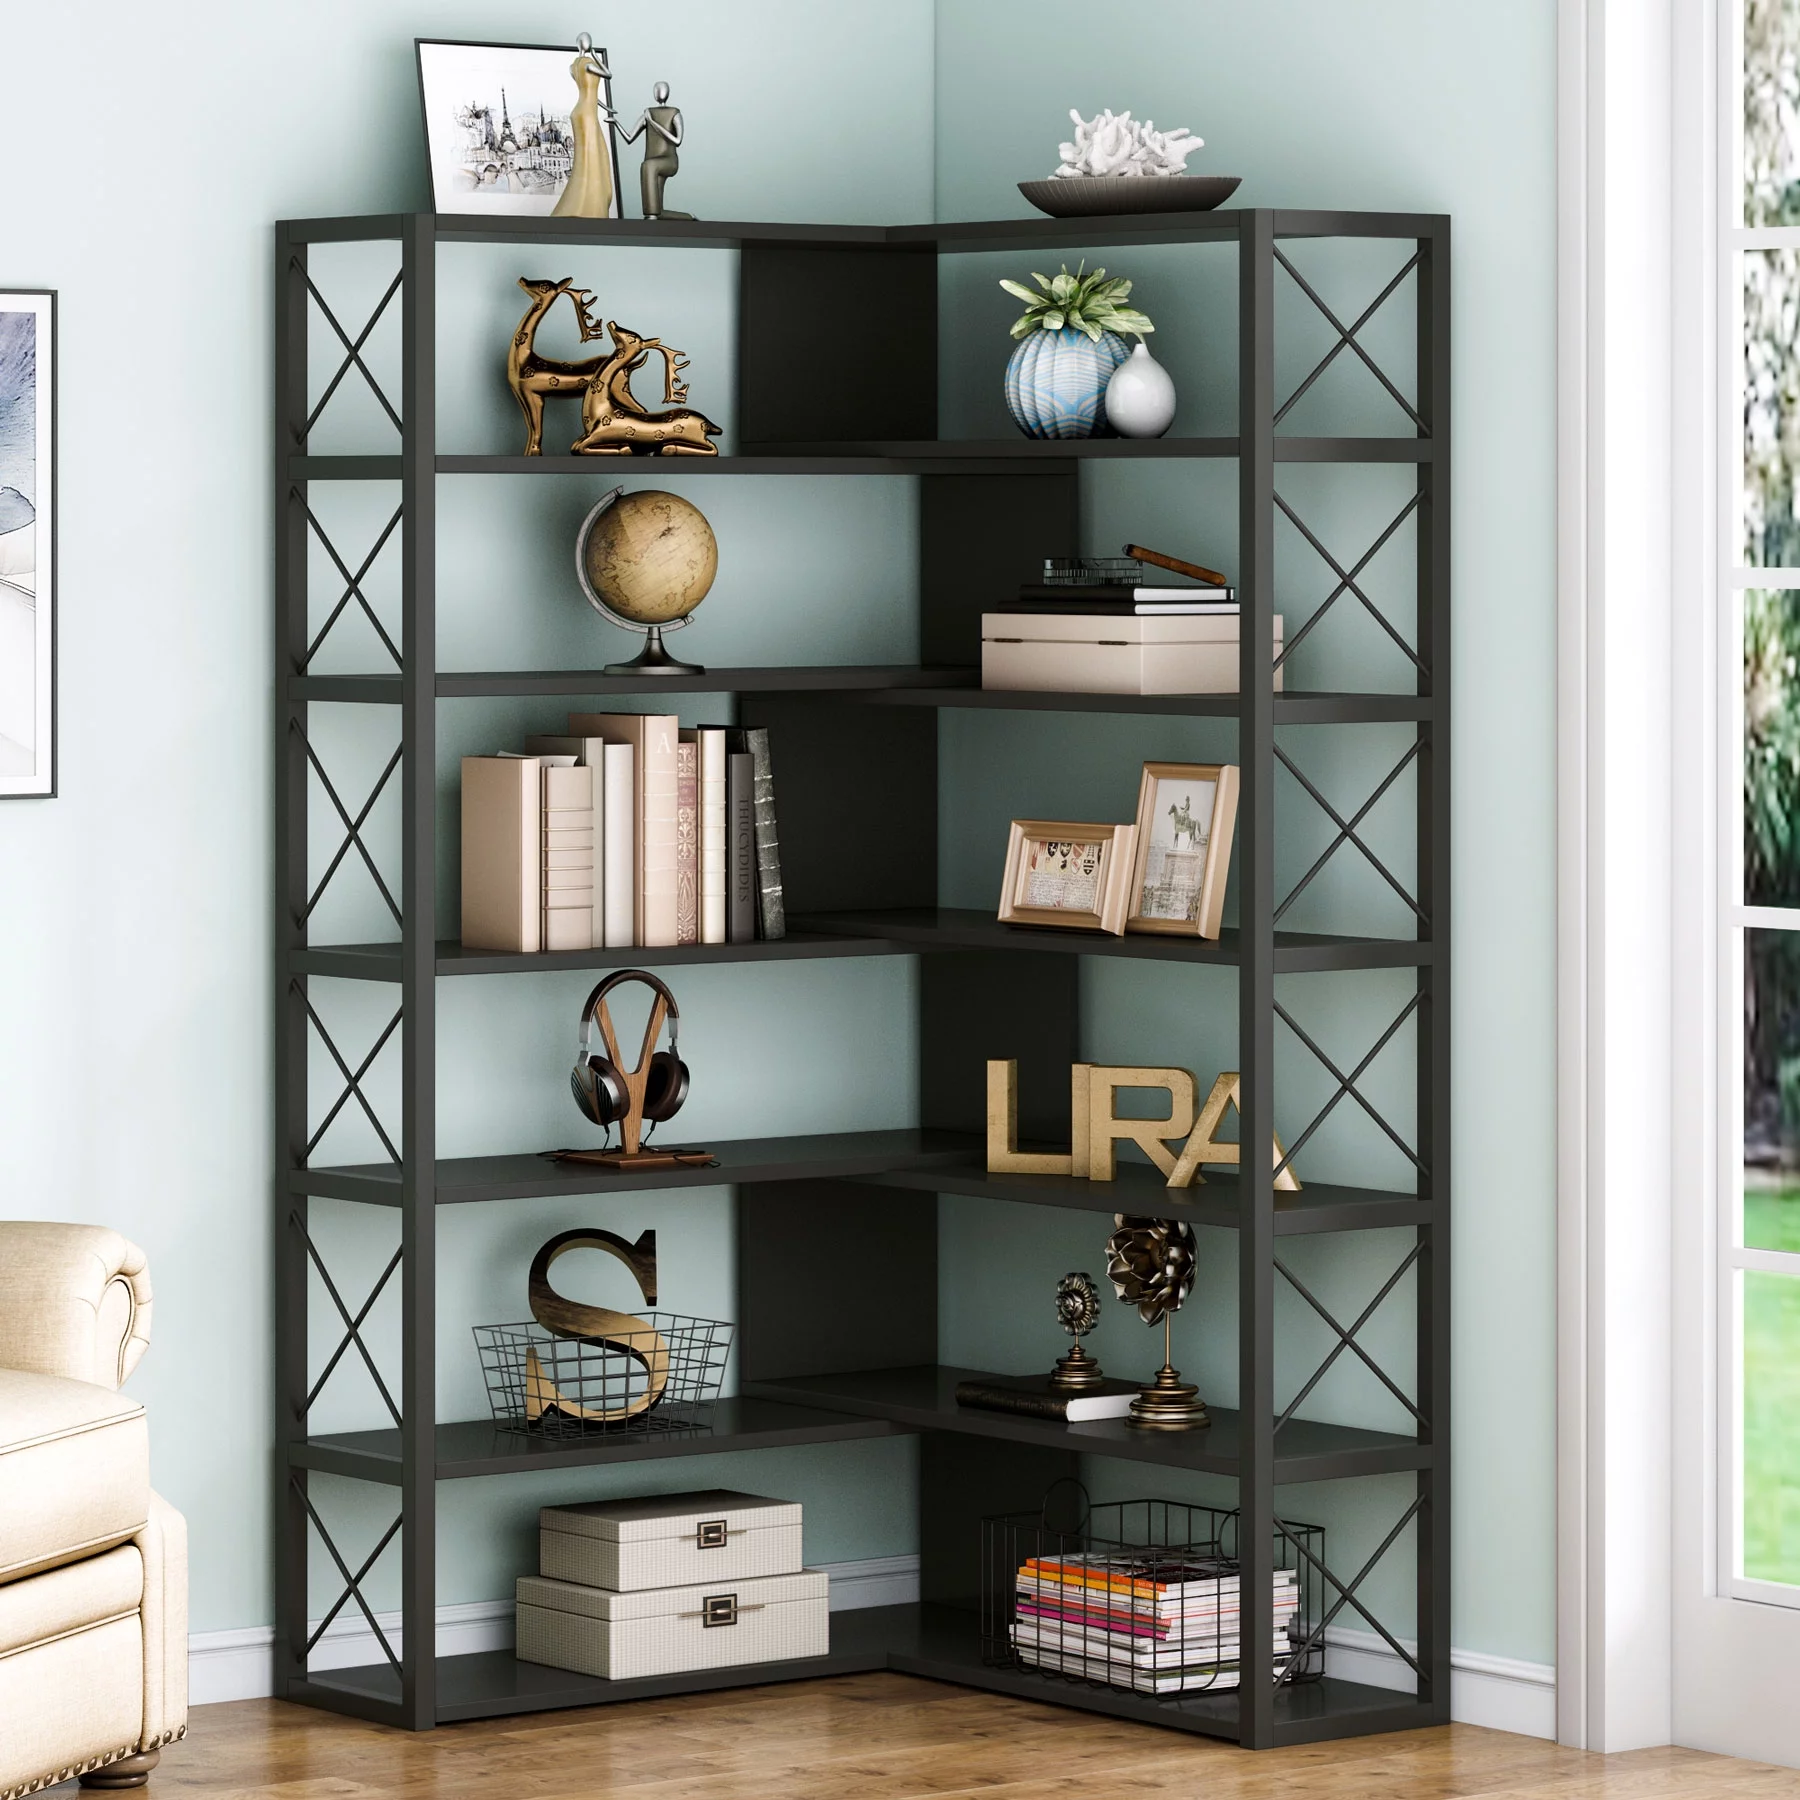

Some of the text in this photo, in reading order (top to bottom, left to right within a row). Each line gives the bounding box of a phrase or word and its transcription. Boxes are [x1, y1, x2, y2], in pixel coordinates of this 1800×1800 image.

[656, 733, 671, 753] A
[738, 796, 751, 903] THUCYDIDES
[525, 1228, 670, 1428] S
